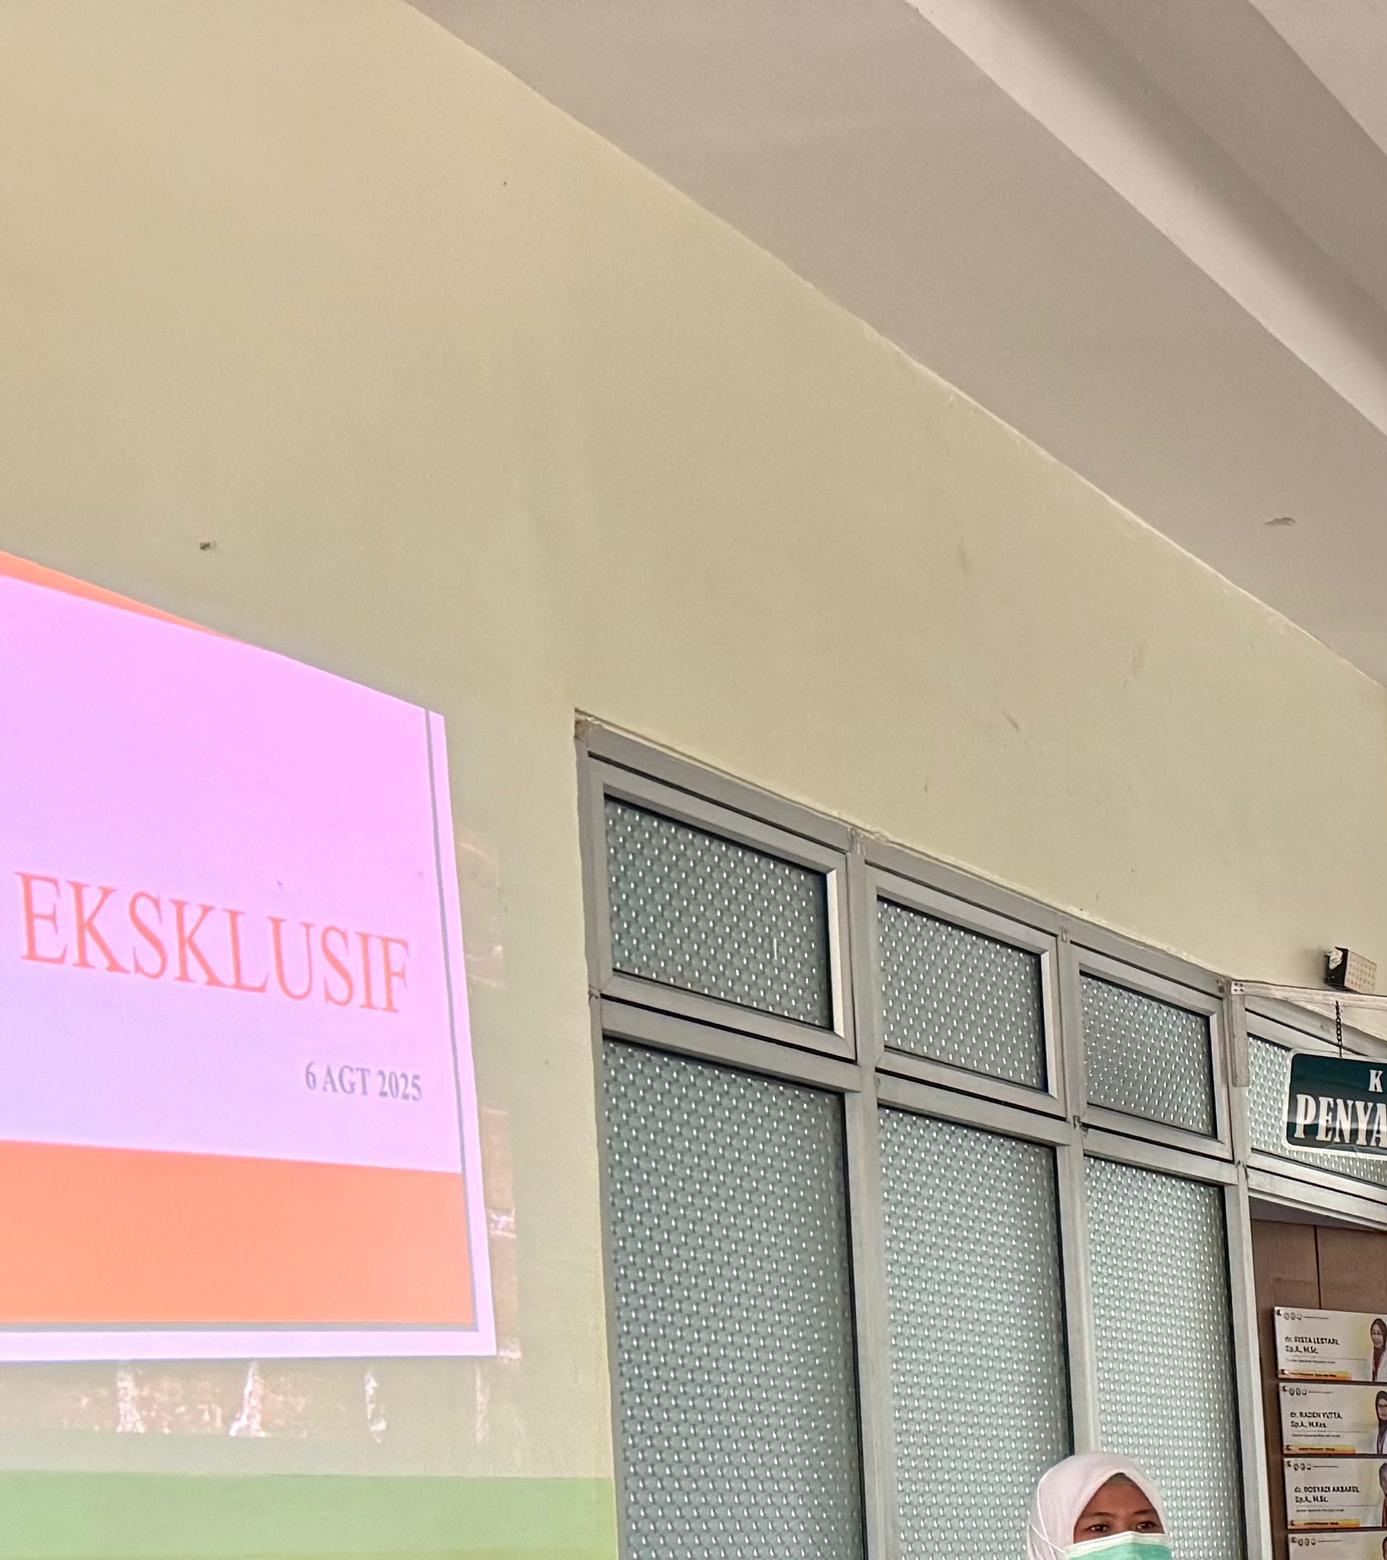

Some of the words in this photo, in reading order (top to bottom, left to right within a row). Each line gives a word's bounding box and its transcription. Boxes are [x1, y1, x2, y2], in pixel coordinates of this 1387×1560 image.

[15, 871, 411, 1013] EKSKLUSIF
[304, 1061, 317, 1091] 6
[322, 1065, 371, 1097] AGT
[377, 1069, 423, 1101] 2025
